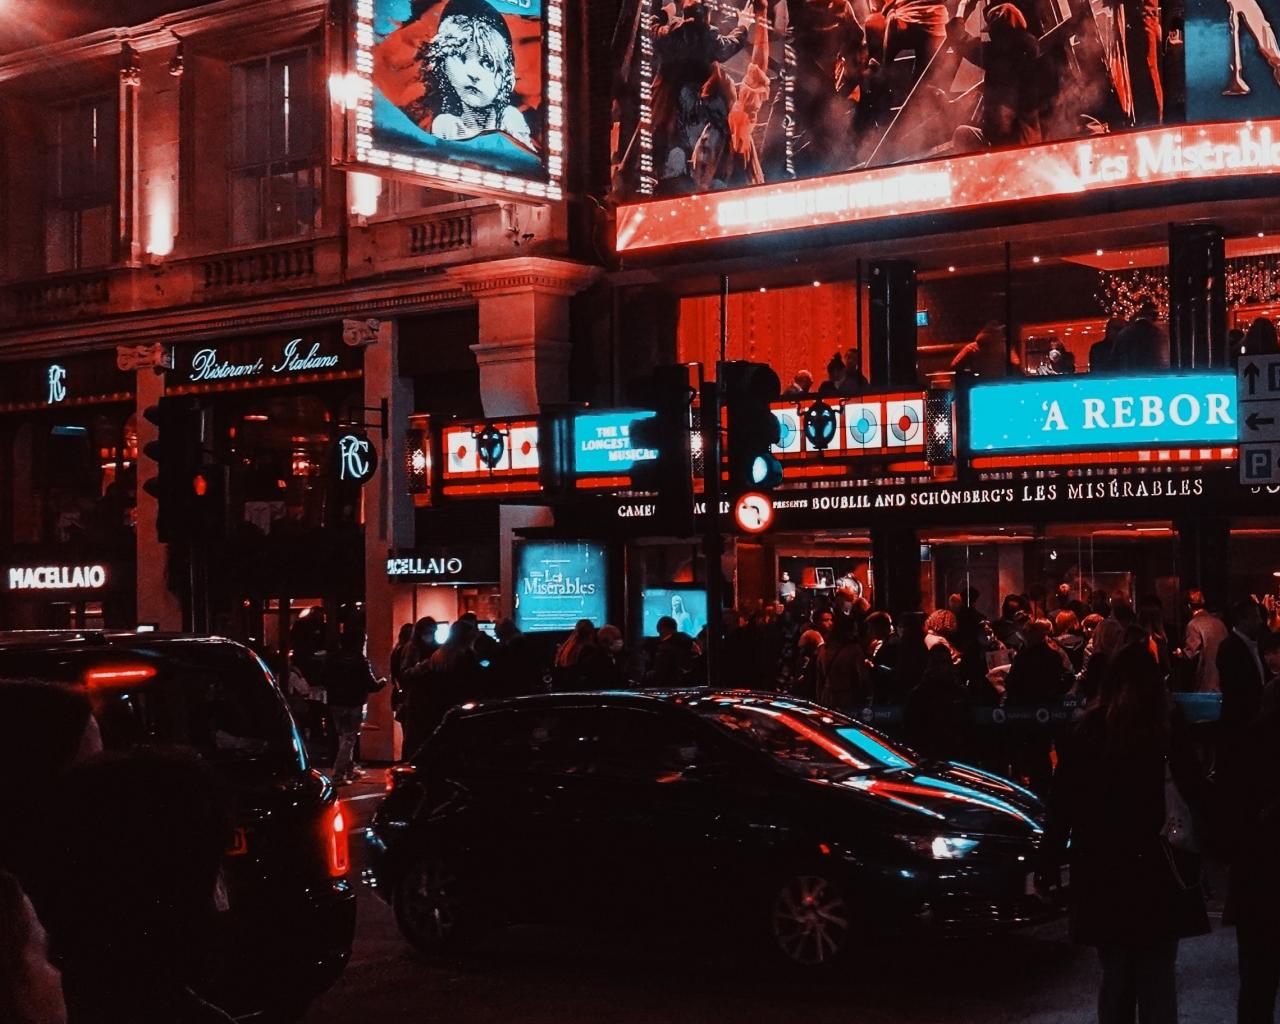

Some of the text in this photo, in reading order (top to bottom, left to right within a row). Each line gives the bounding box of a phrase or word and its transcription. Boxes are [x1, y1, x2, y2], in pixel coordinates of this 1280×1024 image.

[189, 338, 339, 382] Ristorante Italiano
[1084, 393, 1237, 430] REBOR
[773, 499, 808, 510] PRESENTS
[811, 494, 872, 510] BOUBLIL
[874, 492, 906, 508] AND
[910, 487, 1014, 505] SCHÖNBERG'S
[1021, 484, 1057, 502] LES
[1067, 478, 1203, 499] MISÉRABLES
[9, 564, 106, 589] MACELLAIO
